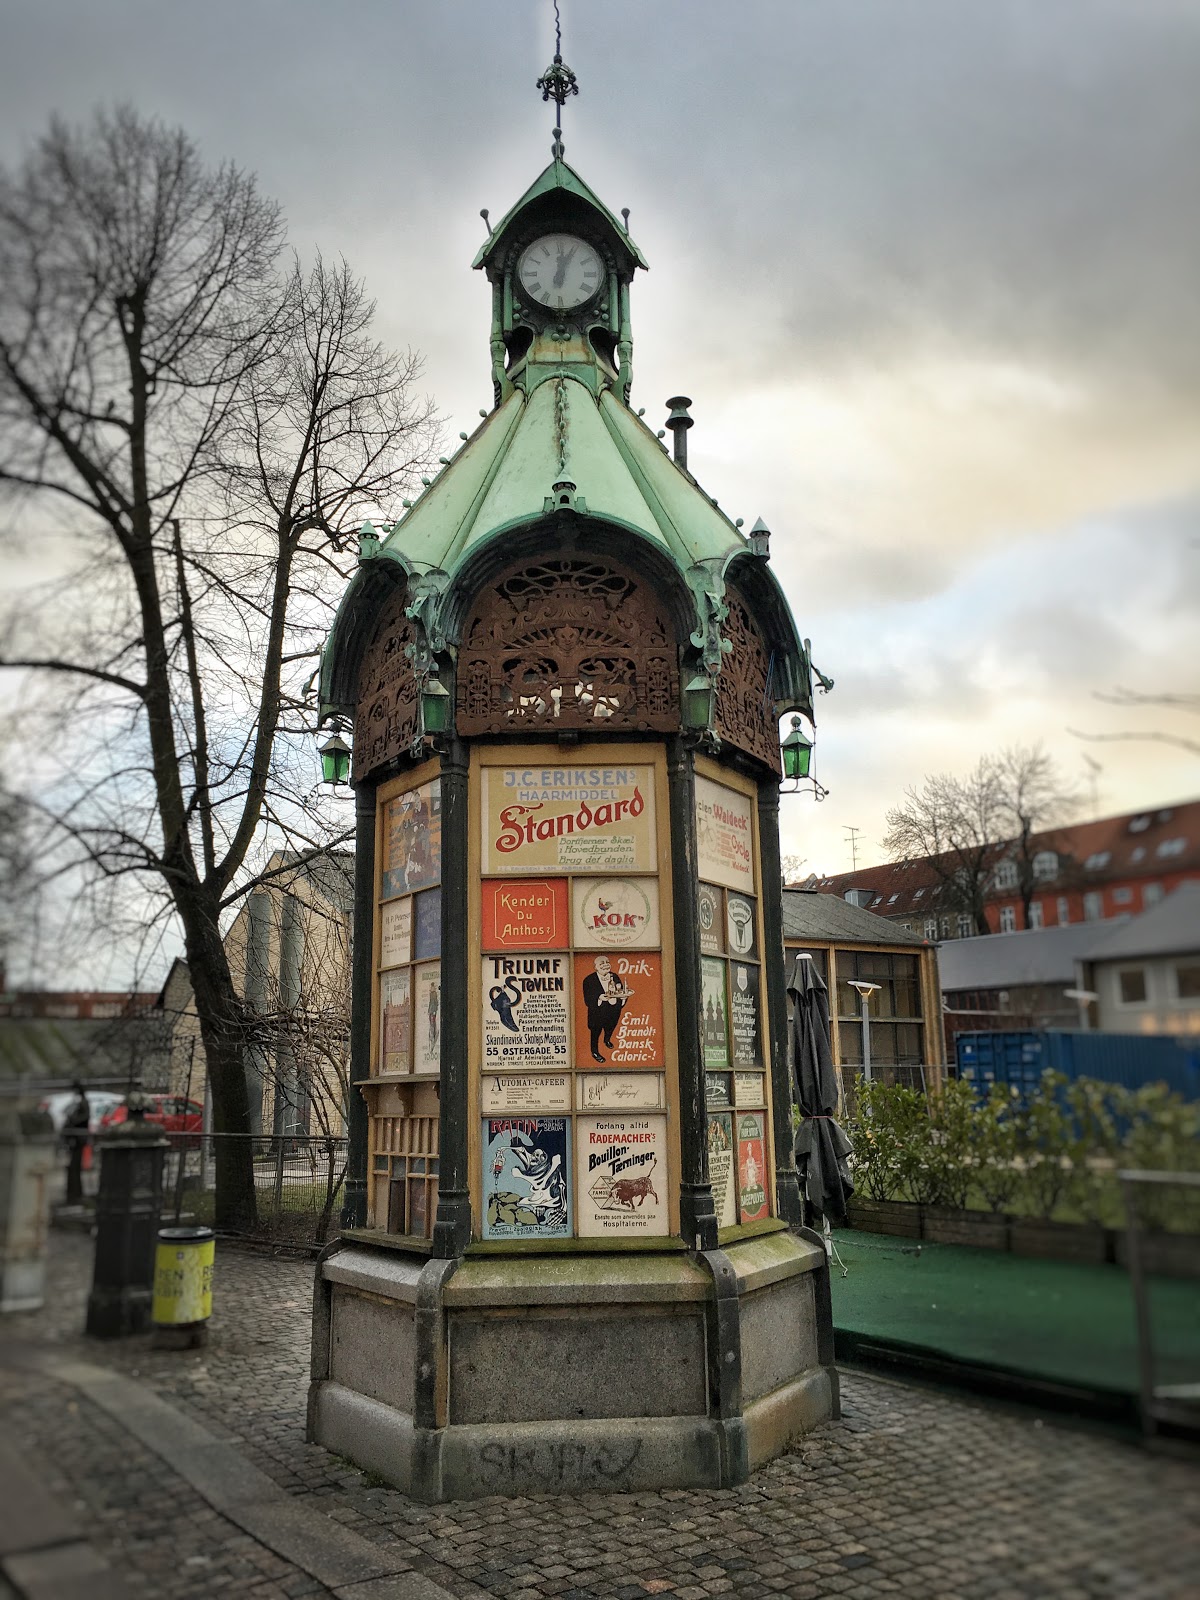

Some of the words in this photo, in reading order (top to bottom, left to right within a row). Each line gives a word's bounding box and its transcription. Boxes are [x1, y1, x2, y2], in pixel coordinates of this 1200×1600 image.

[505, 771, 538, 787] J.C.
[519, 790, 619, 801] HAARMIDDEL
[495, 786, 645, 853] Standard
[501, 894, 550, 913] Kender
[517, 911, 533, 920] Du
[488, 956, 562, 979] TRIUMF
[621, 1011, 650, 1025] Emil
[522, 1025, 565, 1033] Eneforhandling
[486, 1034, 523, 1046] Skandinavisk
[618, 1038, 654, 1051] Dansk
[486, 1047, 499, 1056] 55
[502, 1046, 551, 1055] ØSTERGADE
[554, 1045, 567, 1054] 55
[490, 1077, 565, 1092] AUTOMAT-CAFEER
[491, 1119, 539, 1134] RATIN
[596, 1122, 625, 1130] Forlang
